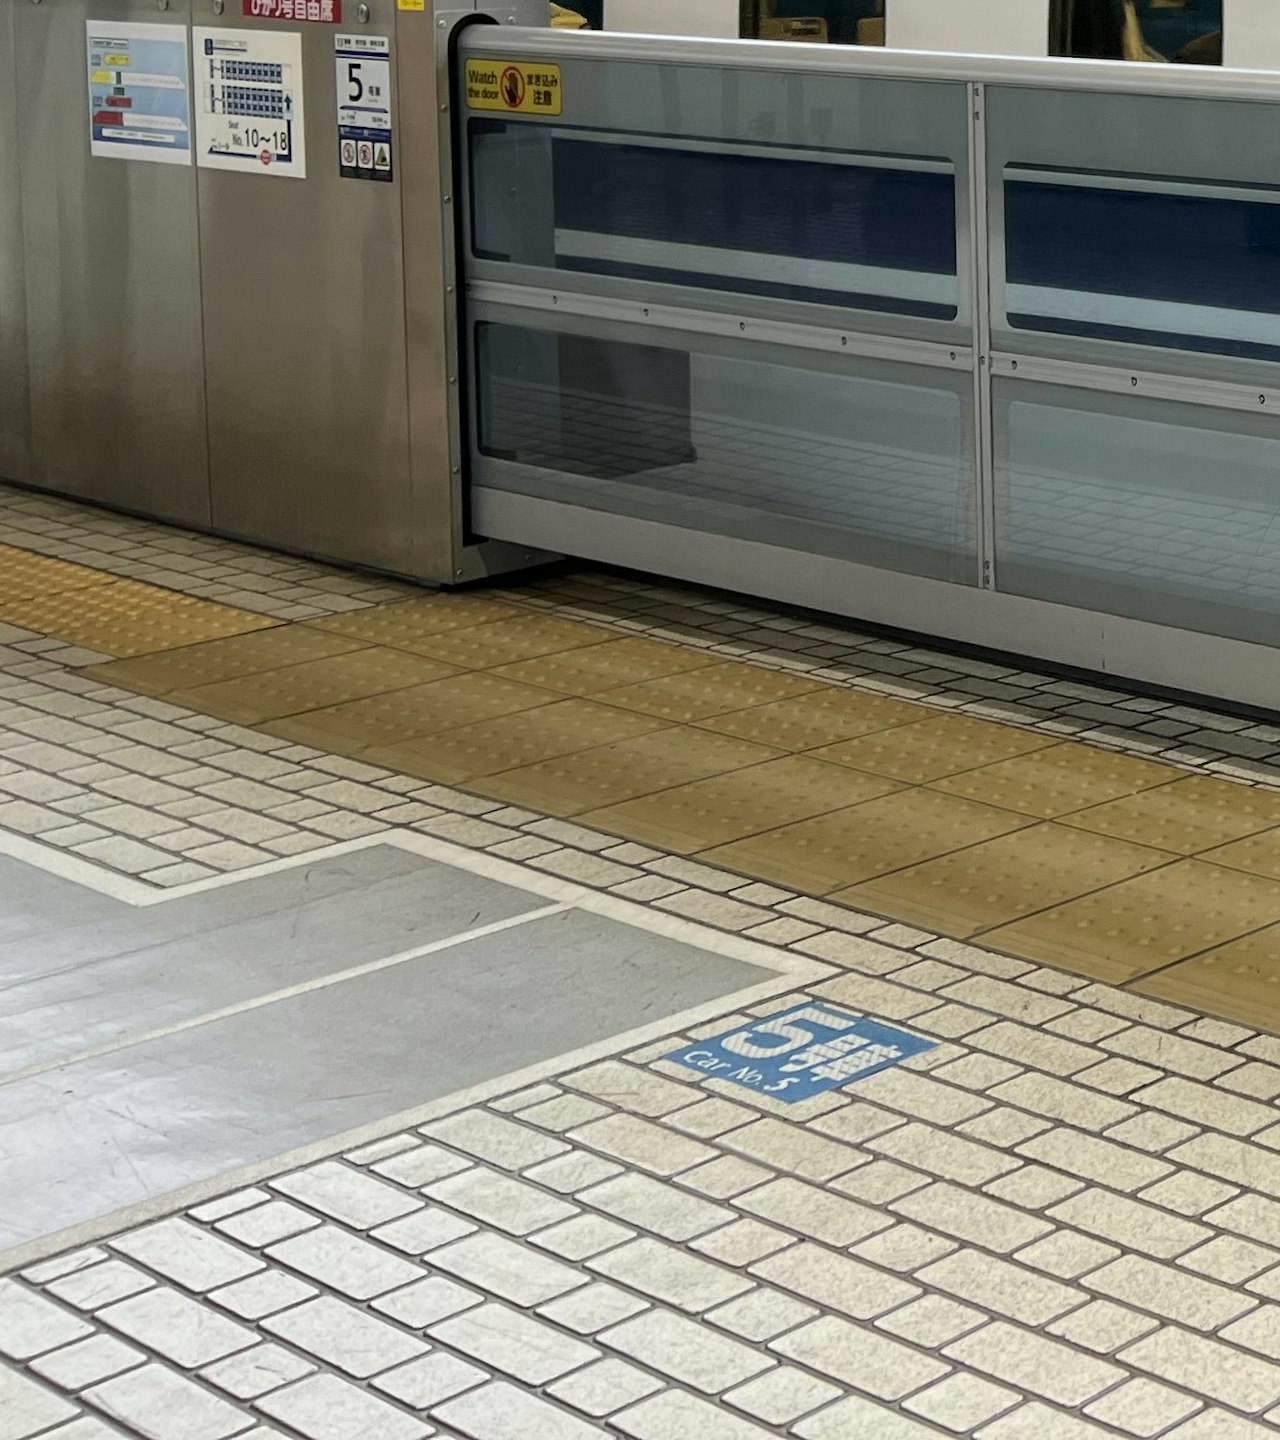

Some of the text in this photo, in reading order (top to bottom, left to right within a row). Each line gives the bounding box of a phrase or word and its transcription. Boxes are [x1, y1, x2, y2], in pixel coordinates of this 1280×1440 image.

[348, 63, 362, 101] 5
[468, 70, 497, 86] Watch
[526, 74, 558, 88] まき込み
[468, 87, 499, 100] the door
[533, 90, 552, 106] 注意
[721, 1008, 856, 1058] 5
[683, 1050, 800, 1091] Car No. 5
